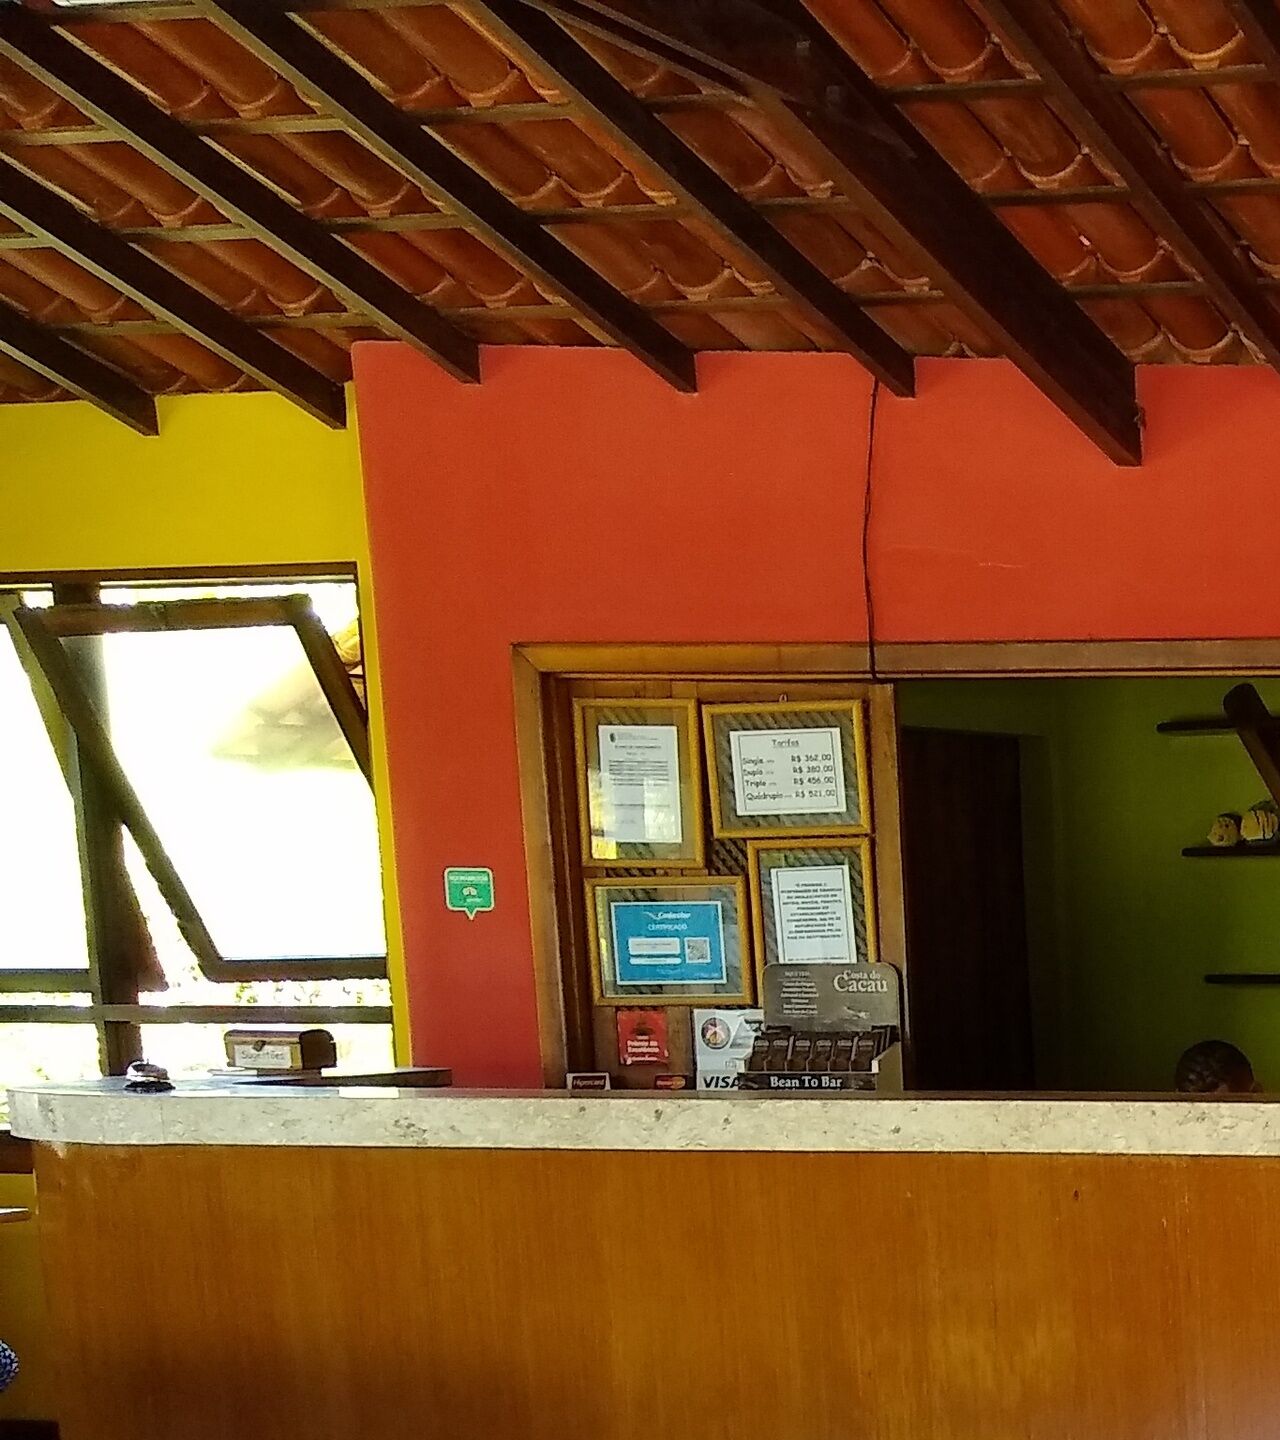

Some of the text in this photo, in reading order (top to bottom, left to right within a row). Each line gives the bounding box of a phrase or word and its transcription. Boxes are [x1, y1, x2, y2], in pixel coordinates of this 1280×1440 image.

[791, 754, 801, 763] R$
[793, 766, 803, 774] R$
[793, 777, 804, 785] R$
[795, 790, 805, 798] R$
[843, 970, 881, 980] Costa do
[833, 974, 888, 992] Cacau
[703, 1075, 740, 1089] VISA
[770, 1076, 842, 1087] Bean To Bar
